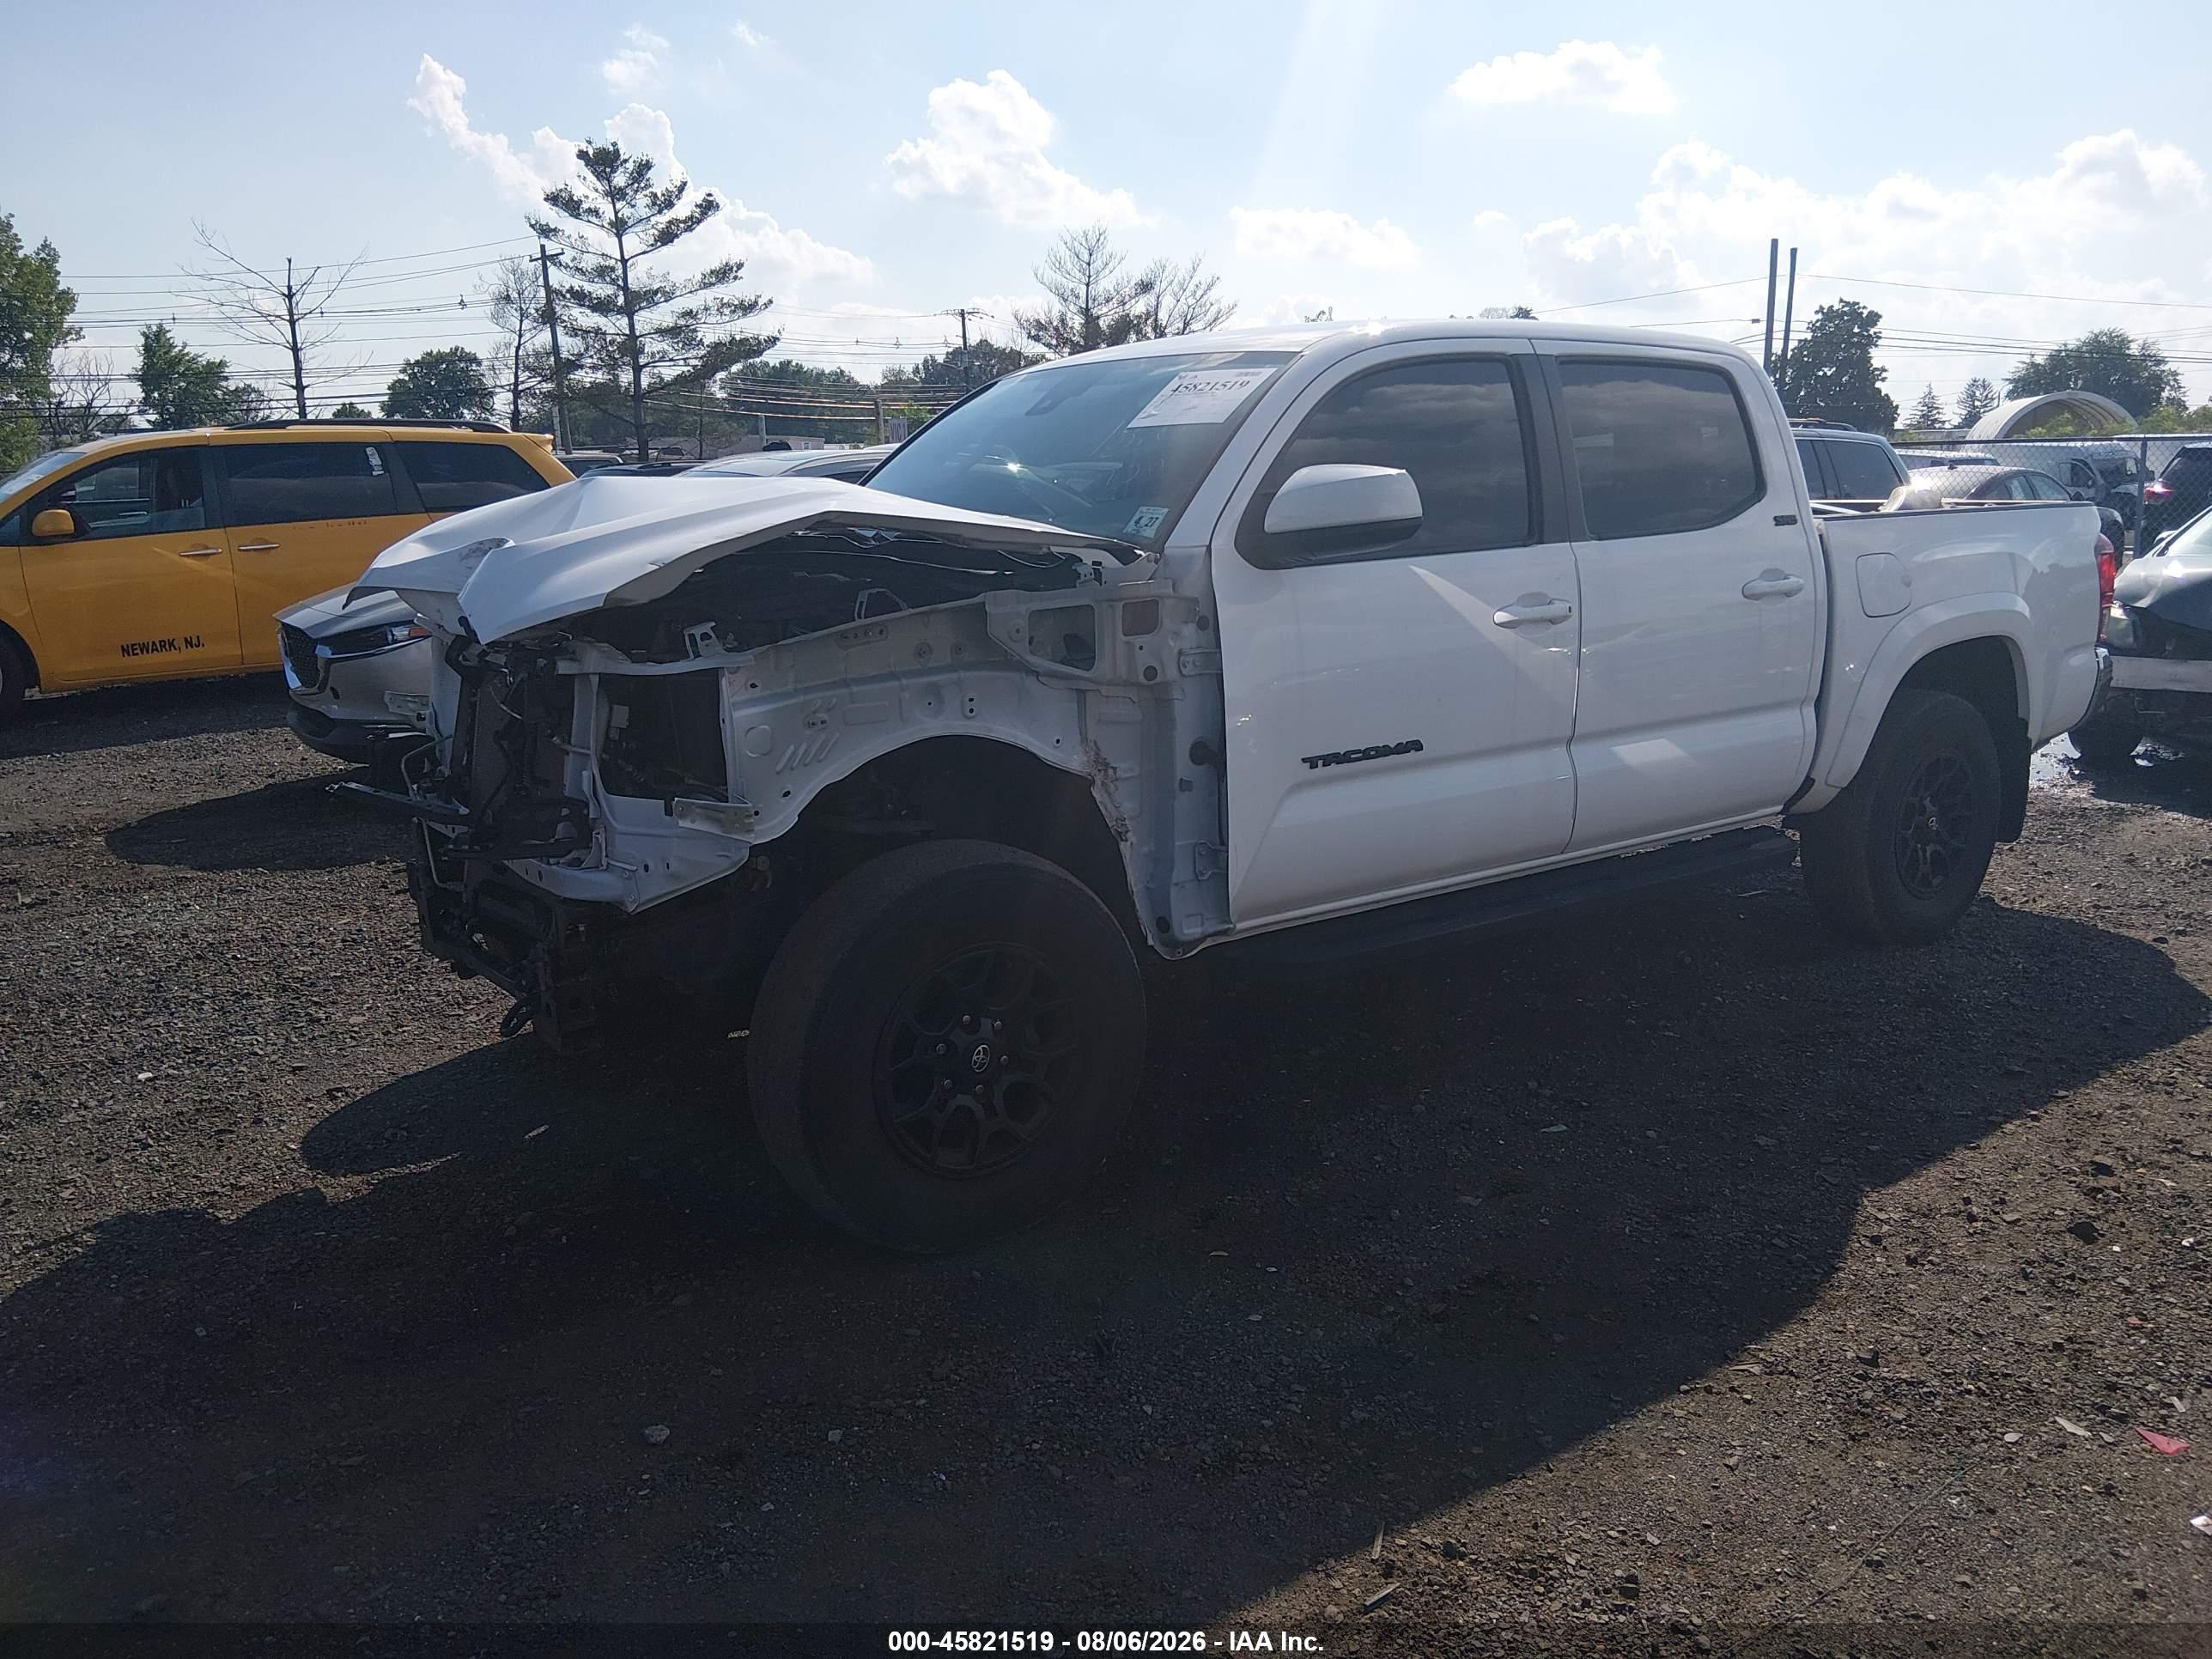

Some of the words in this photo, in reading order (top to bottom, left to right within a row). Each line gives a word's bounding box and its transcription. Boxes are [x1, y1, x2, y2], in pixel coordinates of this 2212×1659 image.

[120, 638, 182, 658] NEWARK,
[184, 635, 205, 649] NJ.
[1301, 739, 1424, 769] TACOMA
